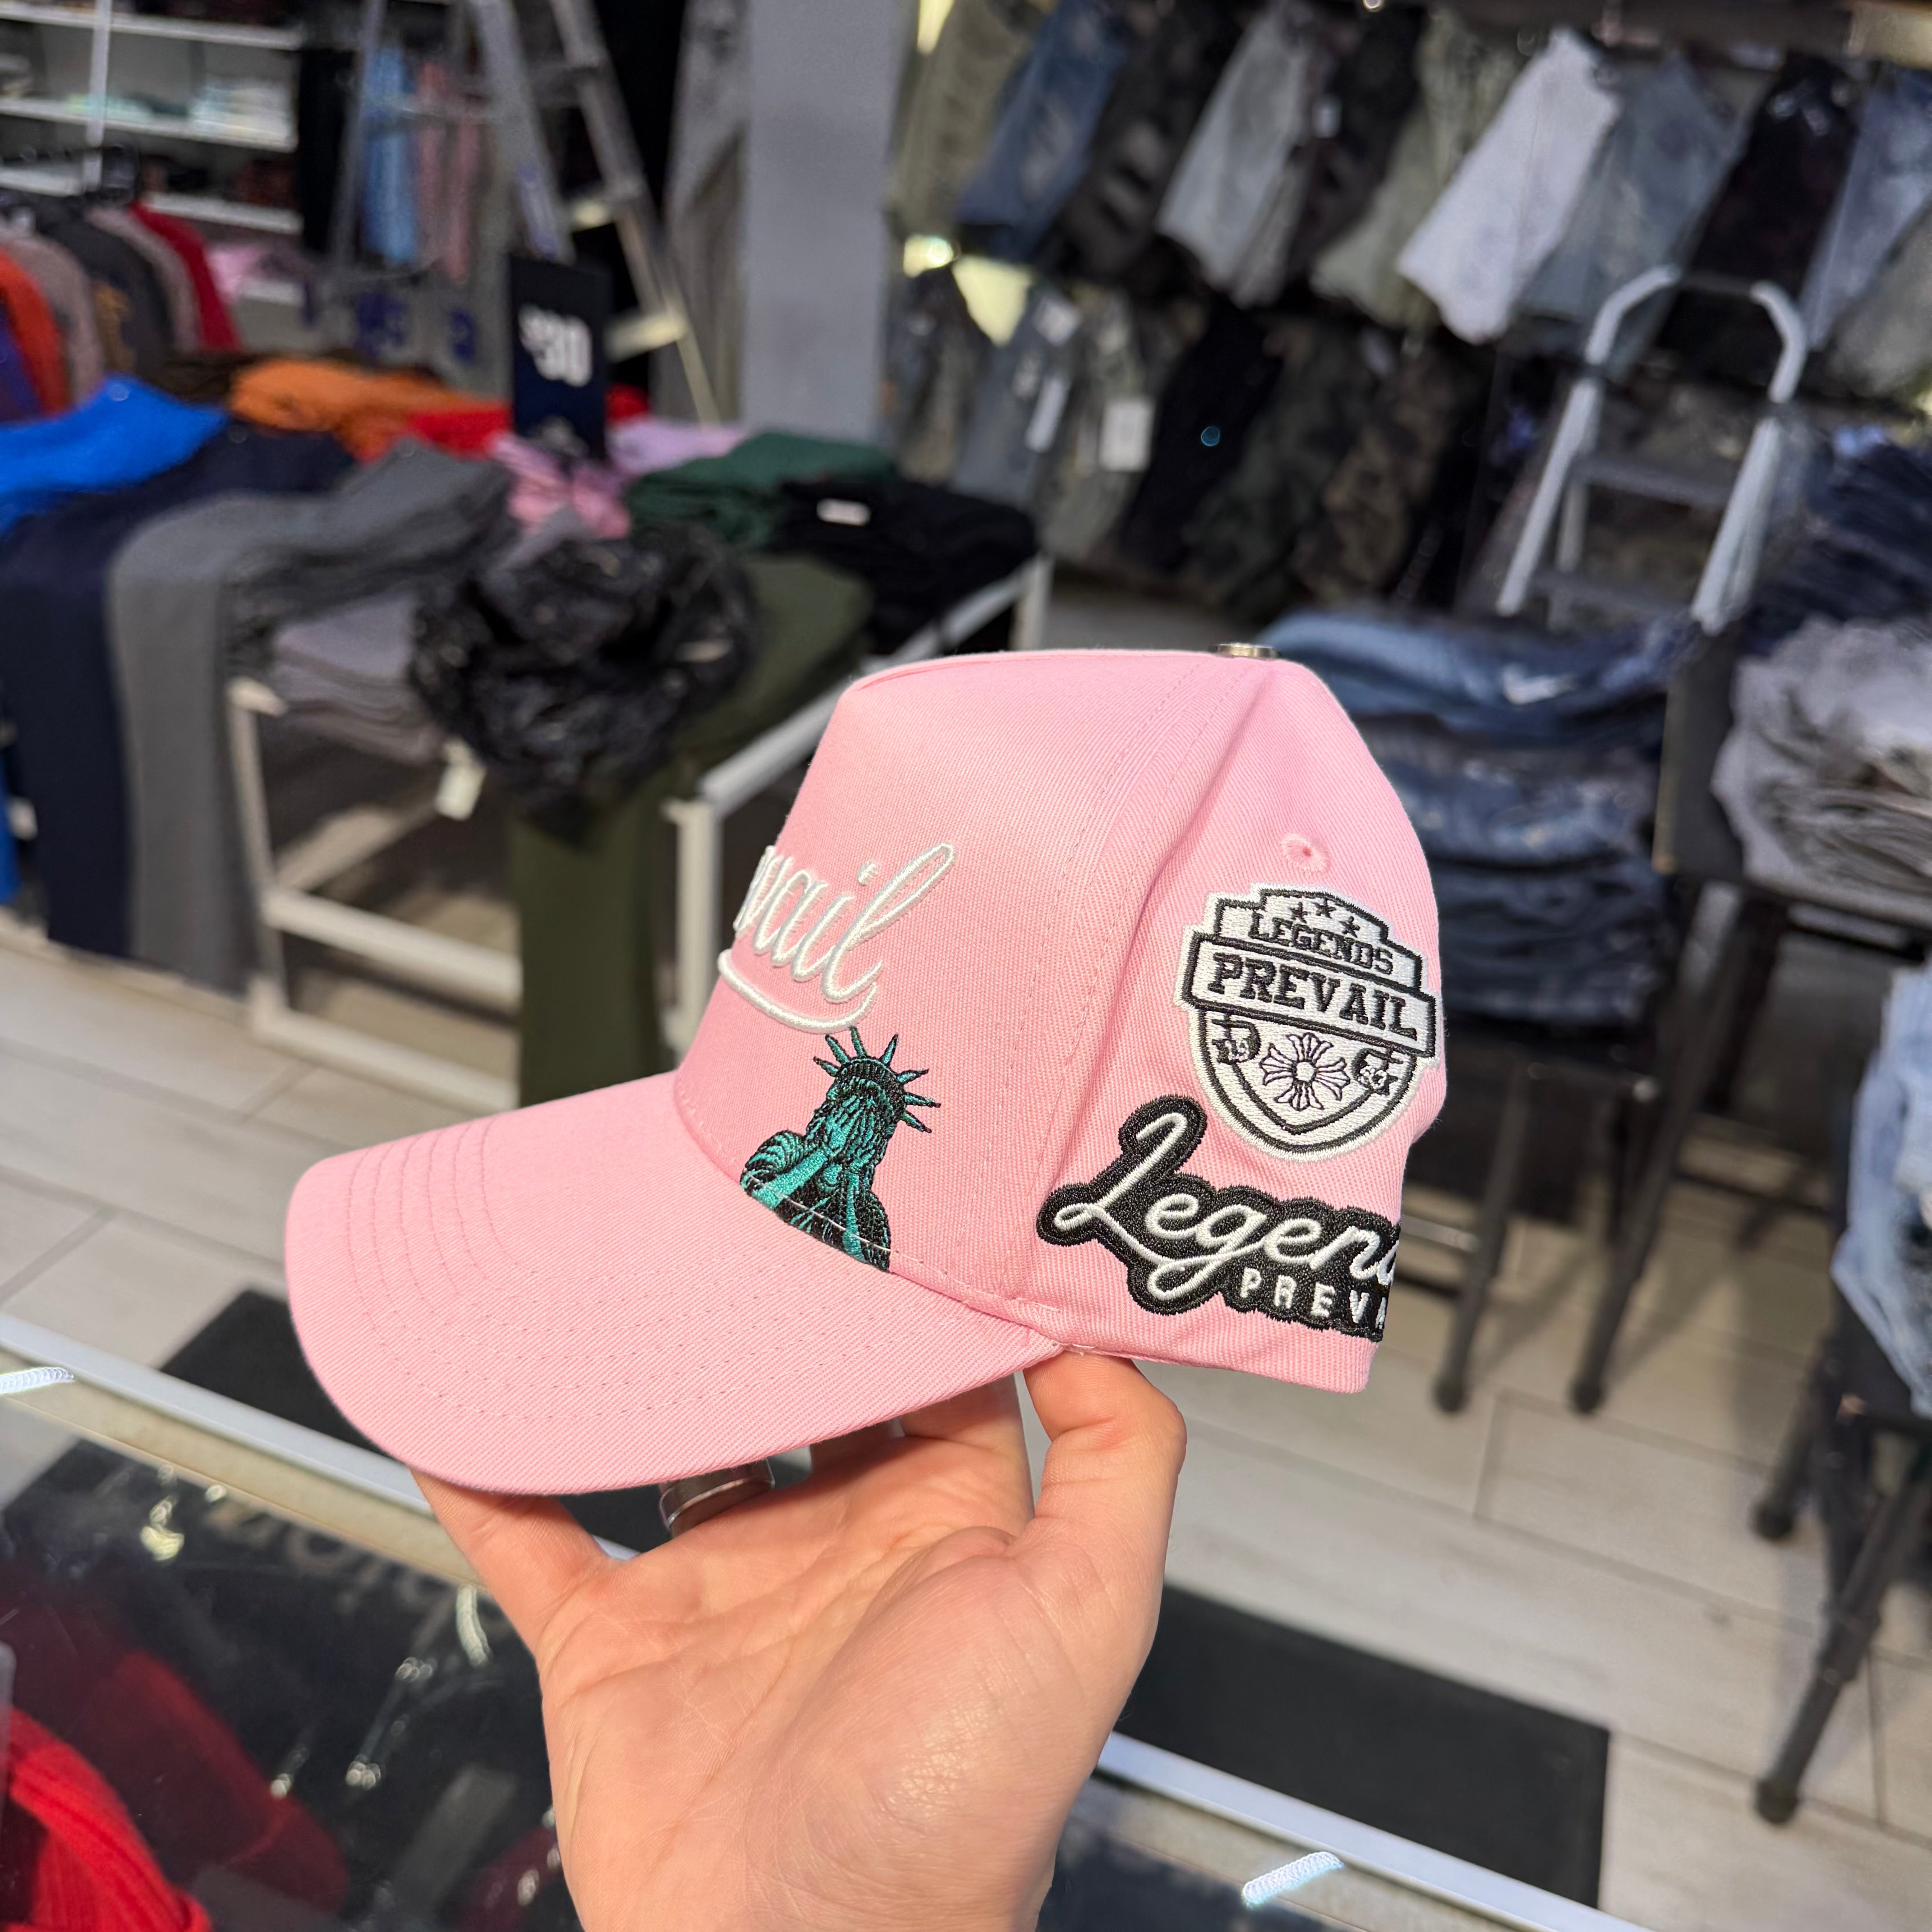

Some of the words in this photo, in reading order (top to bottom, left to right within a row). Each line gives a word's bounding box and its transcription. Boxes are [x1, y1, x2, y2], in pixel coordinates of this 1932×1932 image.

[733, 842, 955, 1005] vail
[1247, 912, 1394, 975] LEGENDS
[1207, 952, 1417, 1041] PREVAIL
